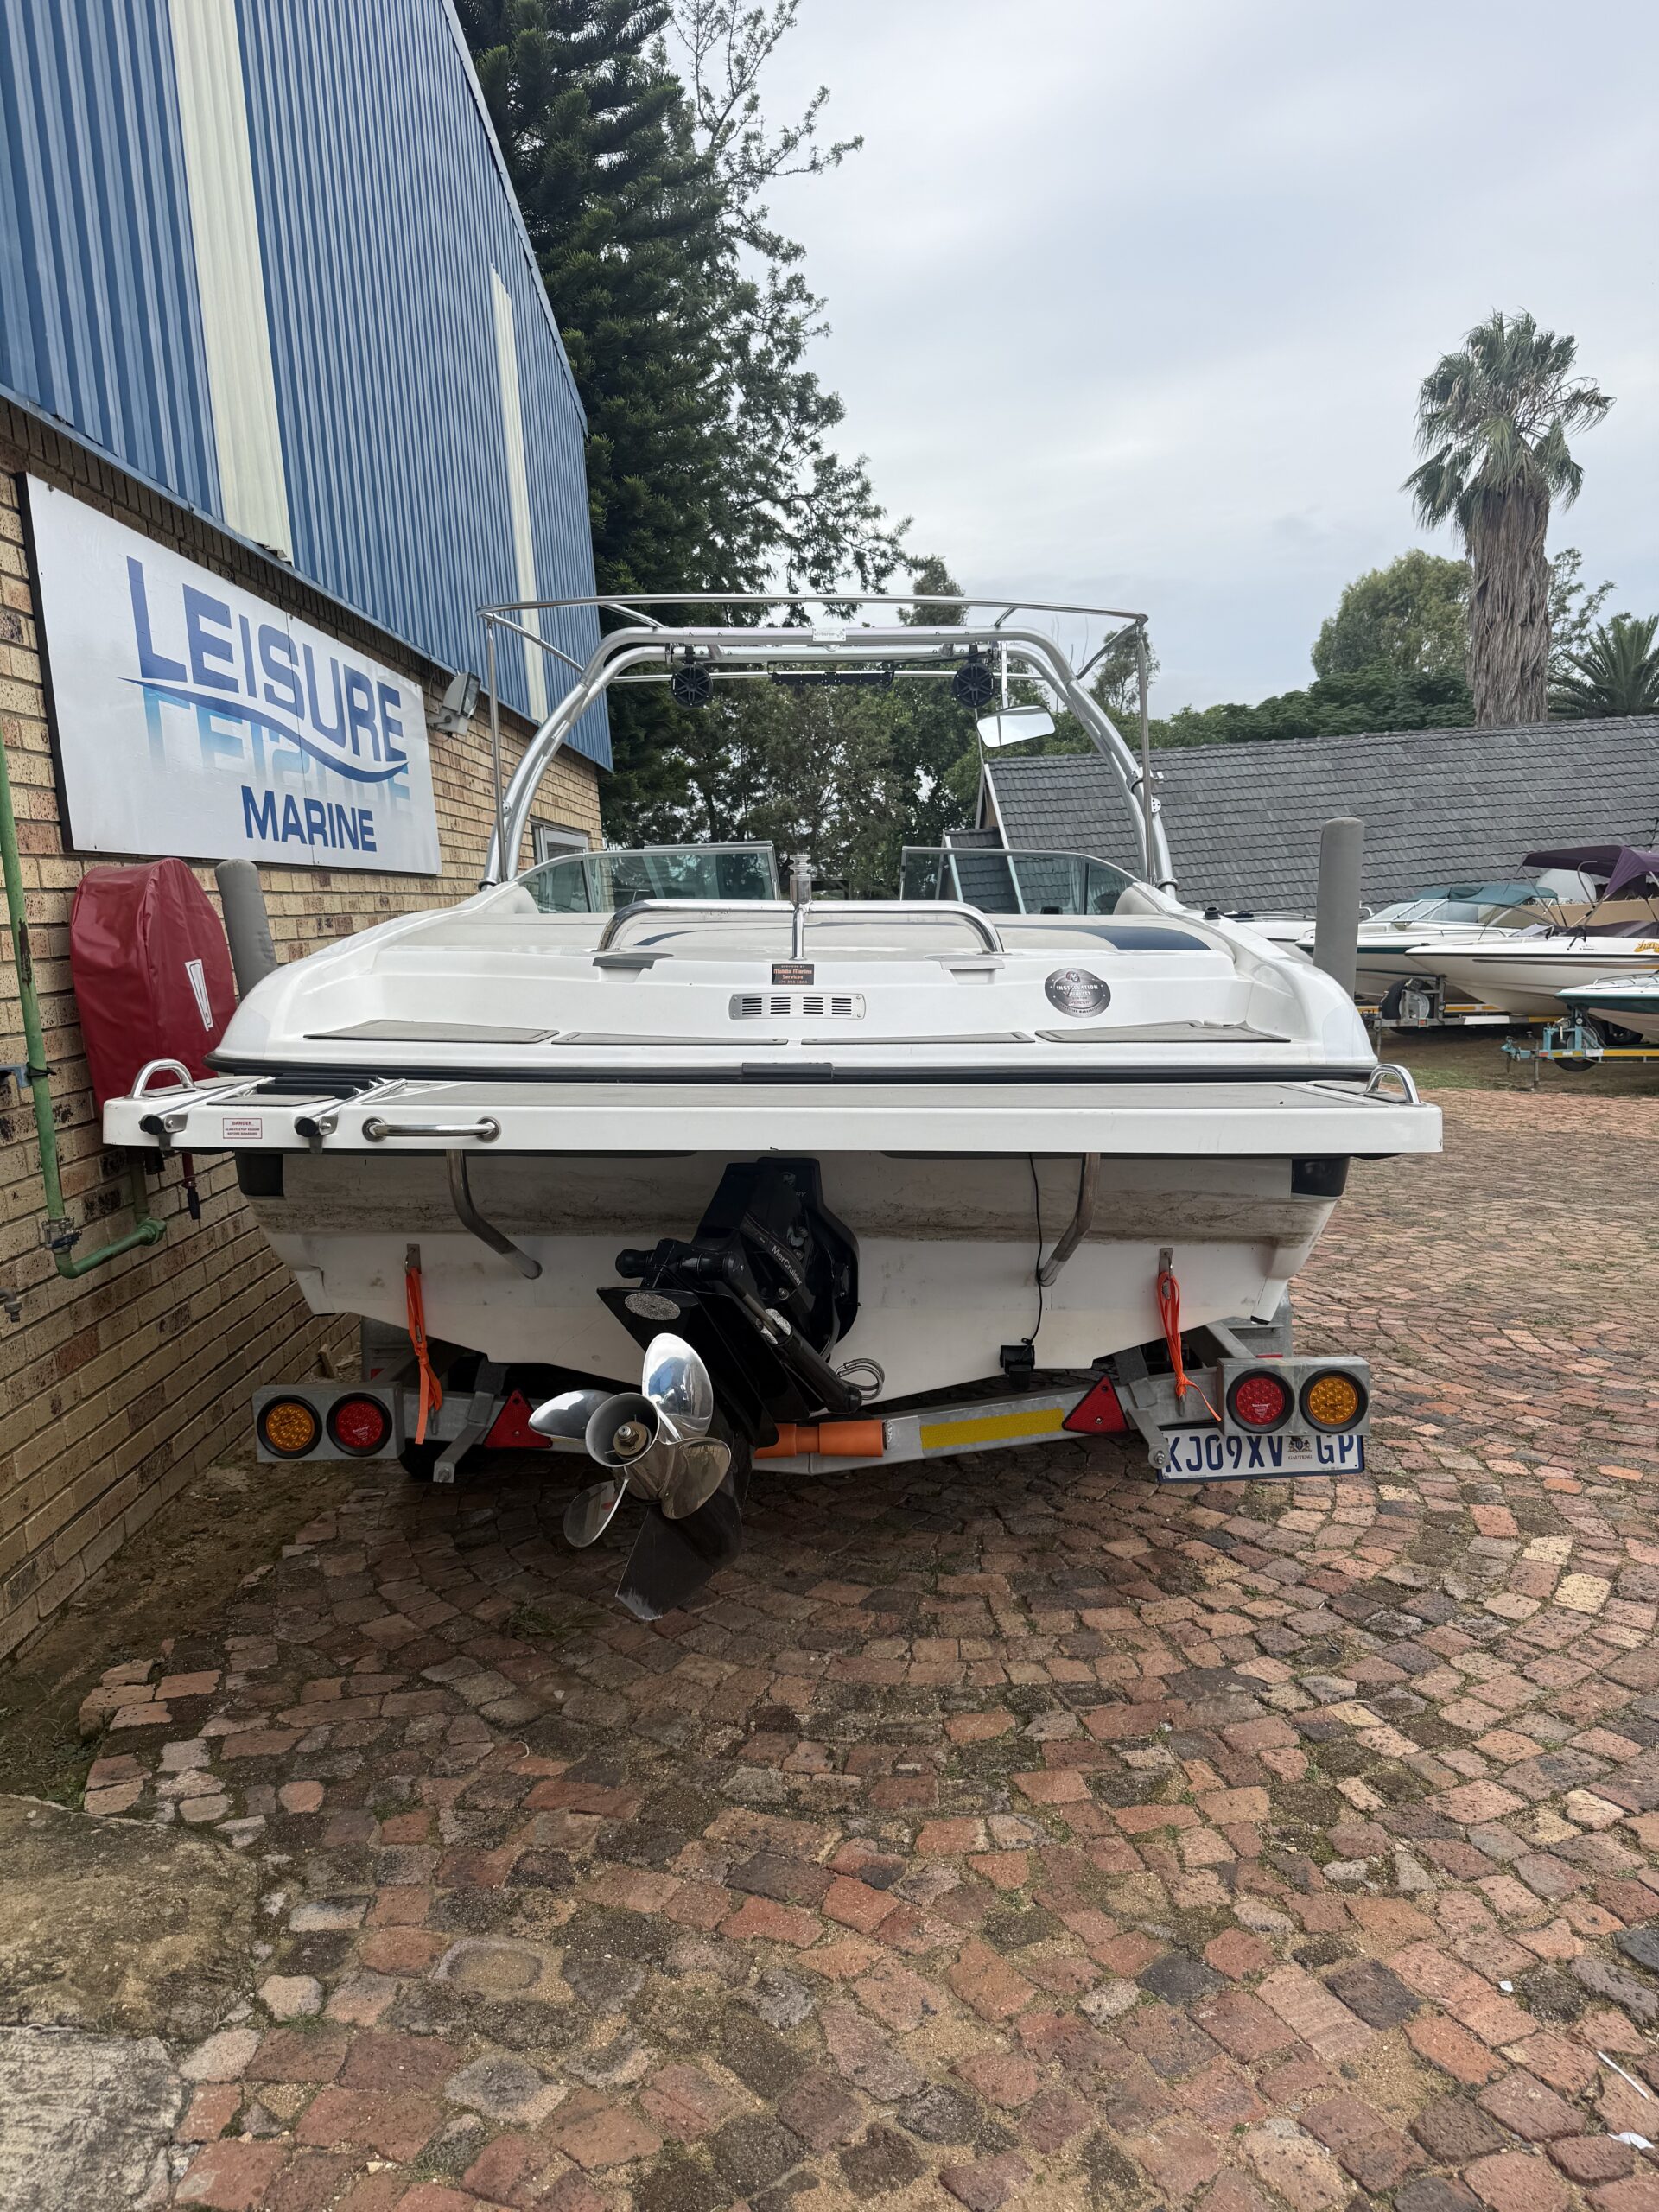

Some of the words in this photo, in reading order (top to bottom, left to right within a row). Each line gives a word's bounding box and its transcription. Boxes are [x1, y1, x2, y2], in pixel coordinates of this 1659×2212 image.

[126, 556, 406, 762] LEISURE
[241, 785, 378, 852] MARINE
[772, 1245, 803, 1286] MerCruiser
[1315, 1434, 1355, 1465] GP
